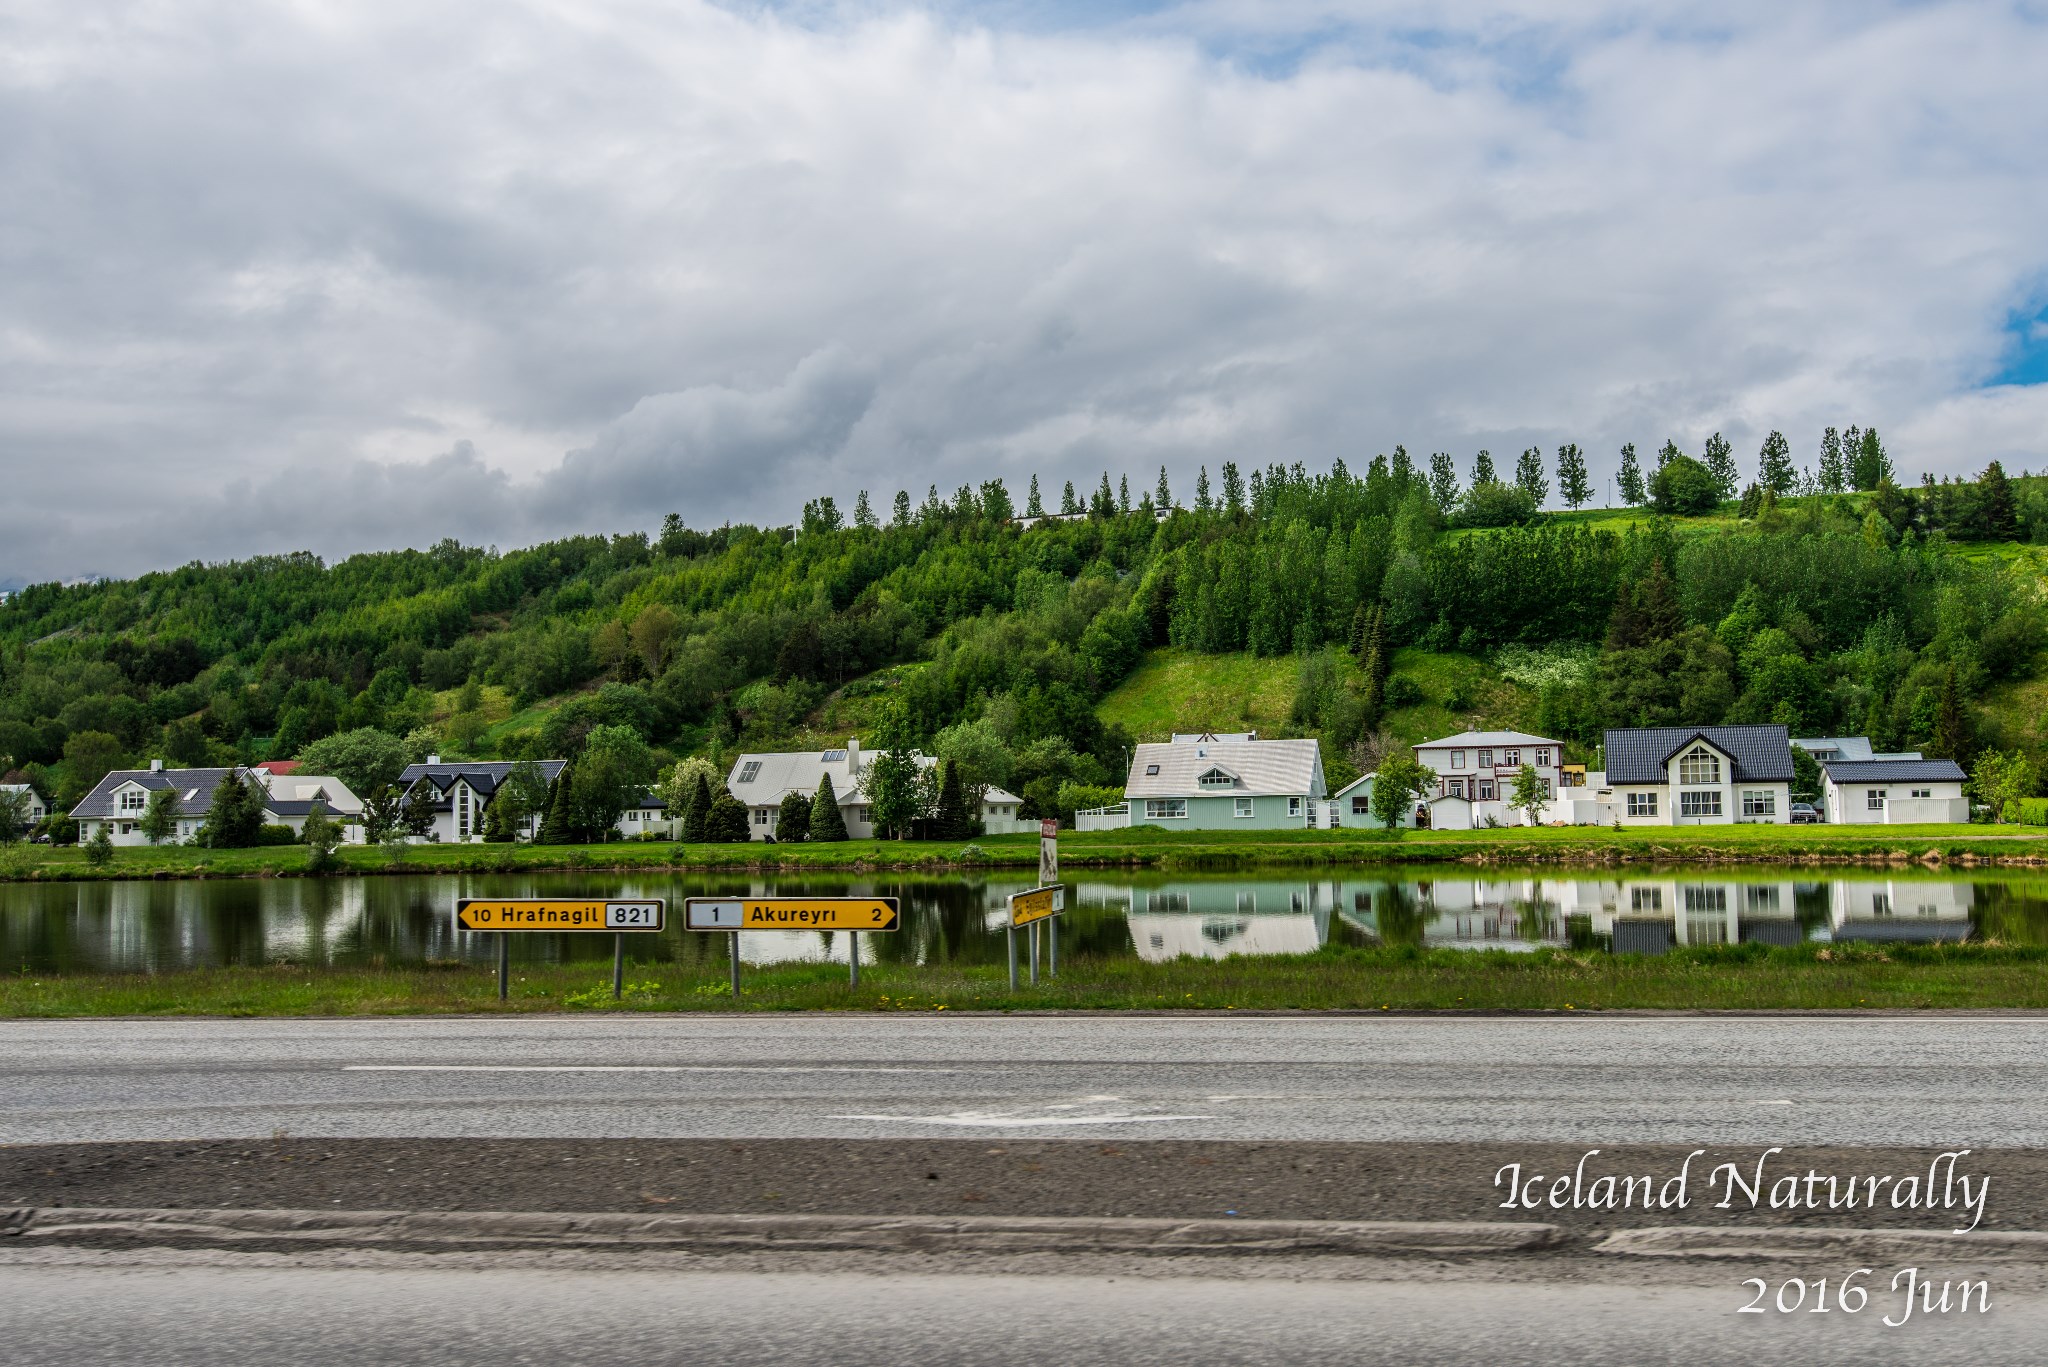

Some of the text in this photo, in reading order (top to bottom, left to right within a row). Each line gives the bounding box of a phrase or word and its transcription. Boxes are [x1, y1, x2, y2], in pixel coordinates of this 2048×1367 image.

[473, 907, 649, 925] 10 Hrafnagil 821
[712, 907, 719, 922] 1
[872, 908, 882, 922] 2
